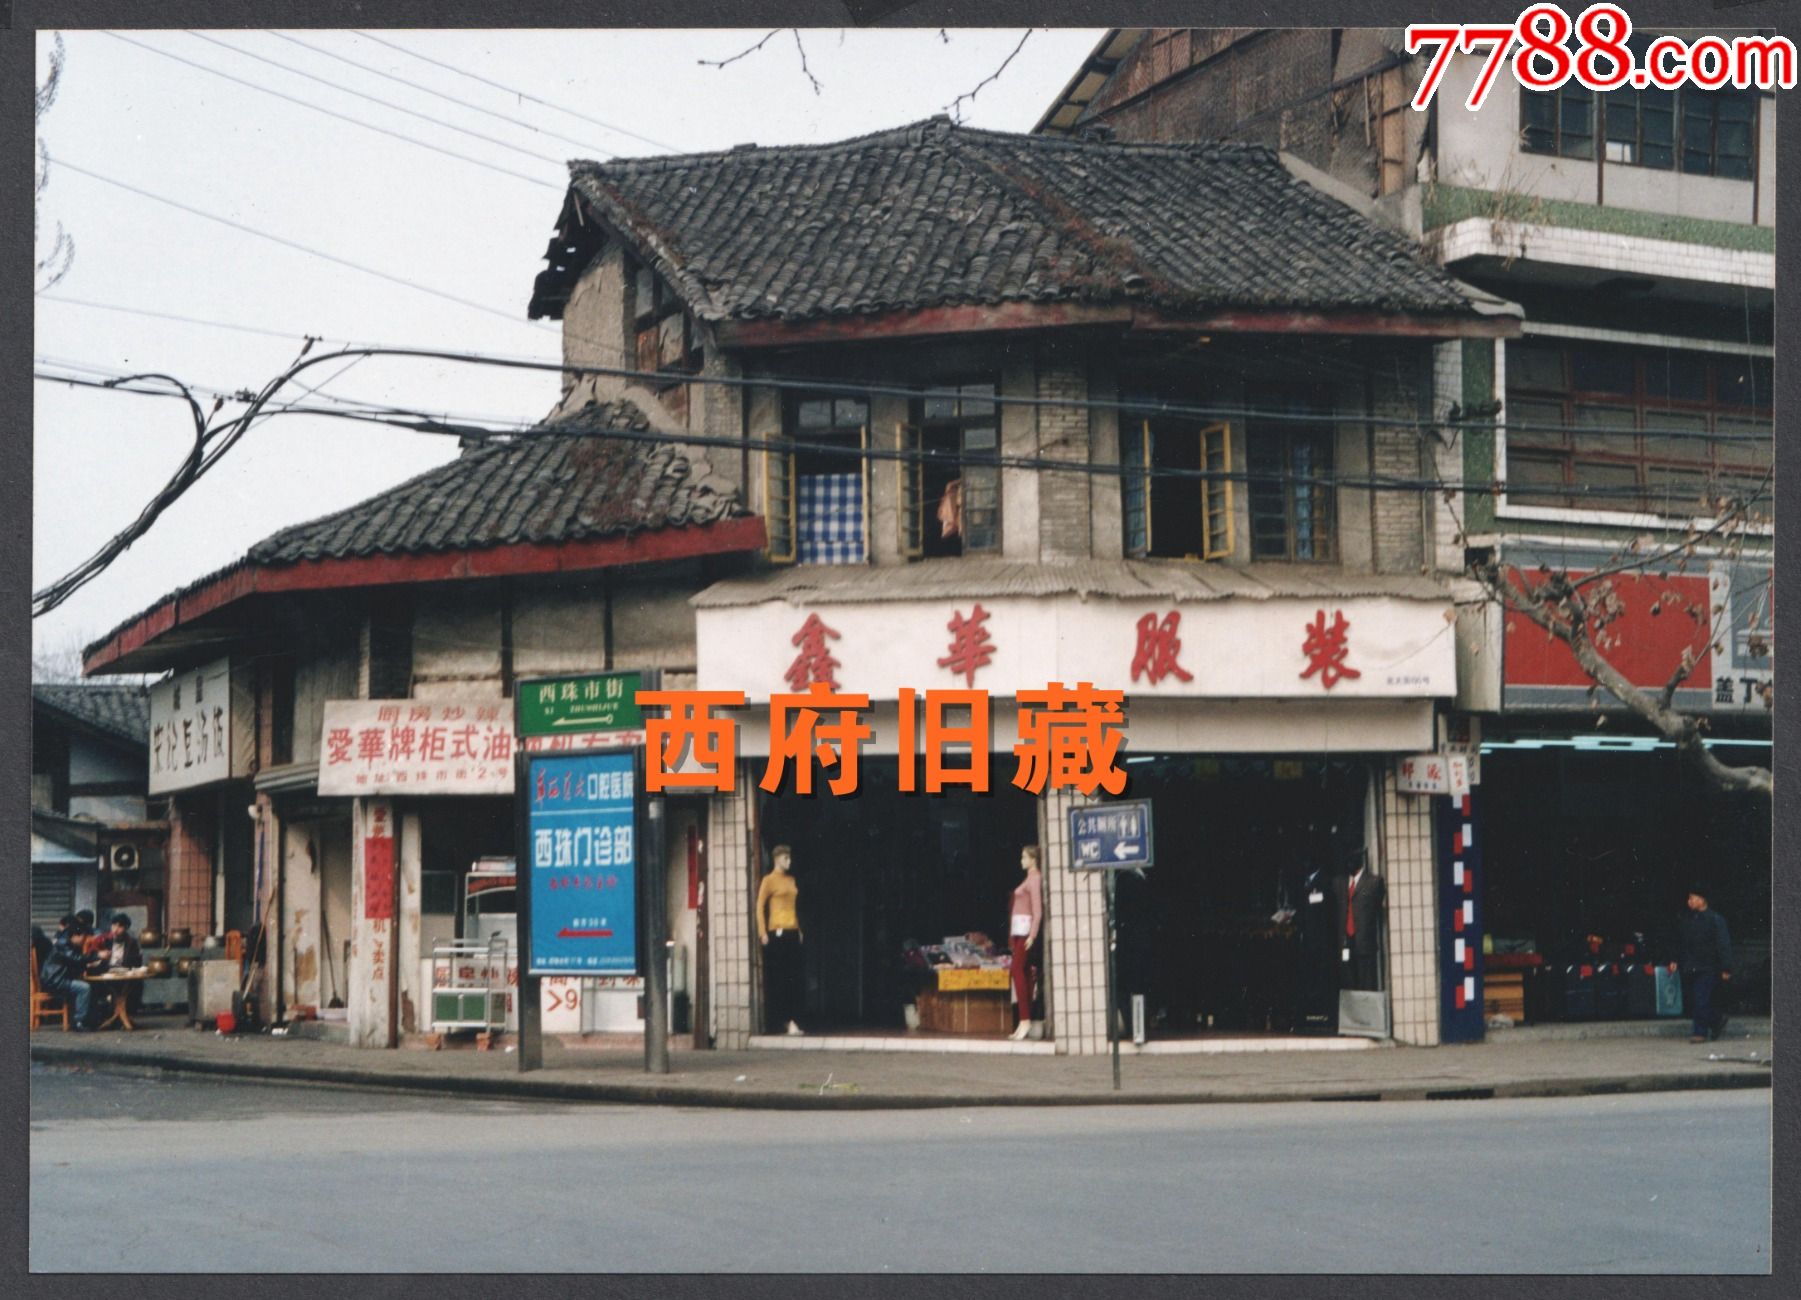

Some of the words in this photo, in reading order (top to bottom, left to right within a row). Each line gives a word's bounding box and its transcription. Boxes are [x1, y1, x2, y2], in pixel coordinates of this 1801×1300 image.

[540, 679, 623, 704] 西珠市街
[1715, 676, 1773, 703] 盖丁
[535, 825, 633, 867] 西珠门诊部
[1080, 841, 1099, 859] WC
